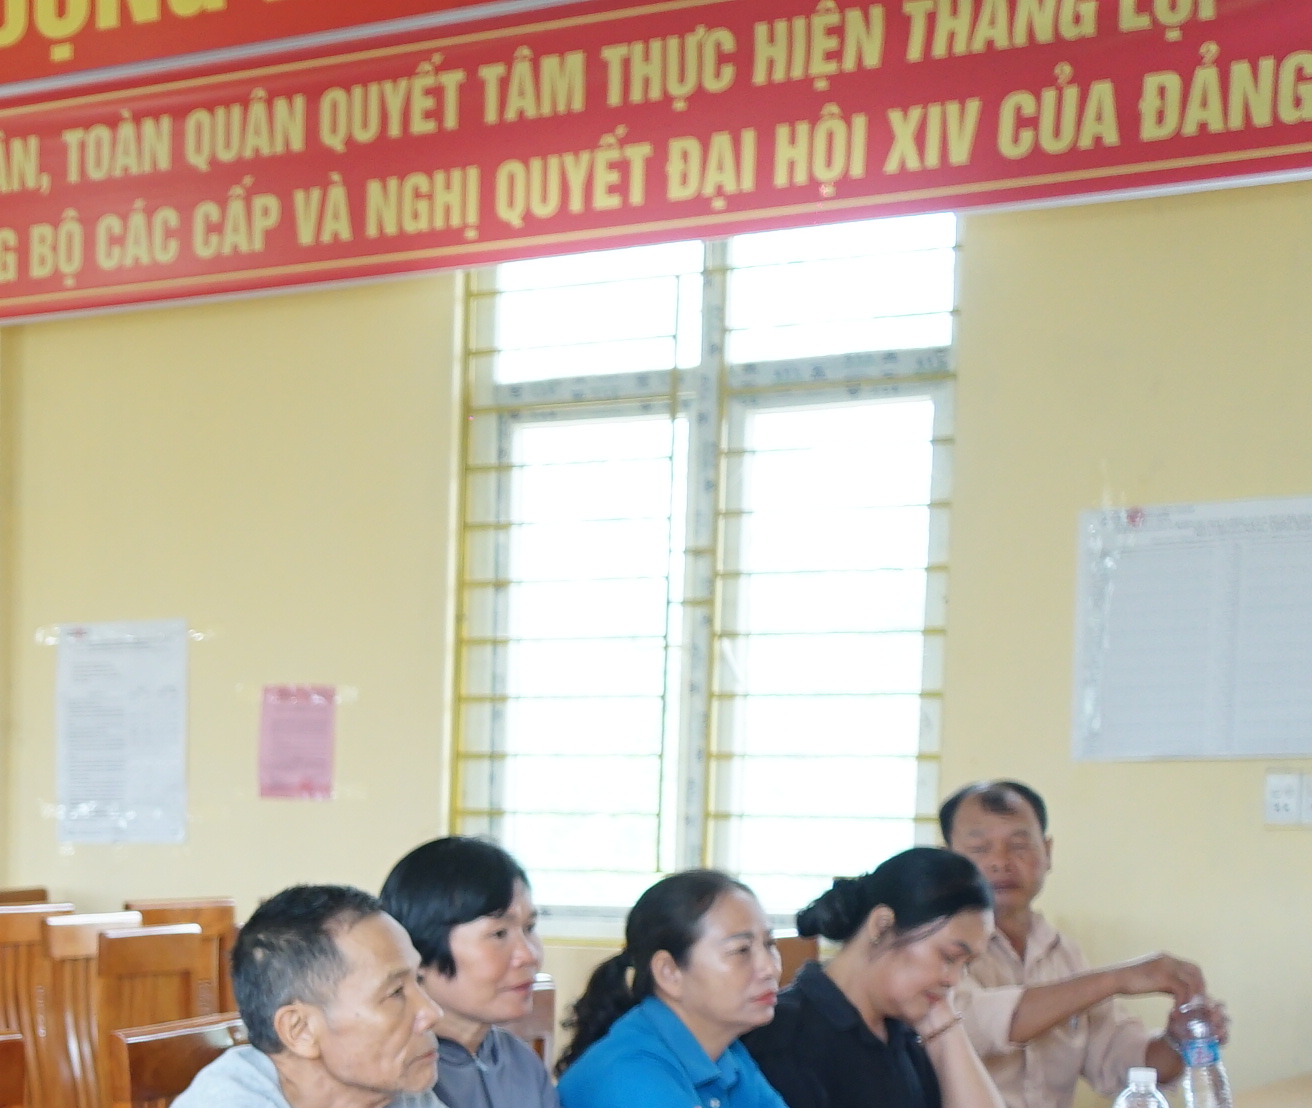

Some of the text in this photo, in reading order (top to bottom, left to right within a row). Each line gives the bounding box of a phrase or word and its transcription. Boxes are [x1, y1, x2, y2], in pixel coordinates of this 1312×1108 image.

[29, 208, 85, 287] BỘ
[95, 198, 180, 271] CÁC
[192, 175, 281, 260] CẤP
[292, 171, 354, 247] VÀ
[365, 164, 481, 239] NGHỊ
[494, 124, 654, 229] QUYẾT
[664, 126, 758, 211] ĐẠI
[773, 101, 869, 198] HỘI
[883, 97, 982, 175] XIV
[997, 60, 1122, 160] CỦA
[1138, 40, 1312, 143] ĐẢNG
[62, 109, 174, 184] TOÀN
[184, 86, 307, 172] QUÂN
[319, 52, 467, 154] QUYẾT
[478, 45, 587, 126] TÂM
[600, 24, 737, 111] THỰC
[751, 0, 886, 90] HIỆN
